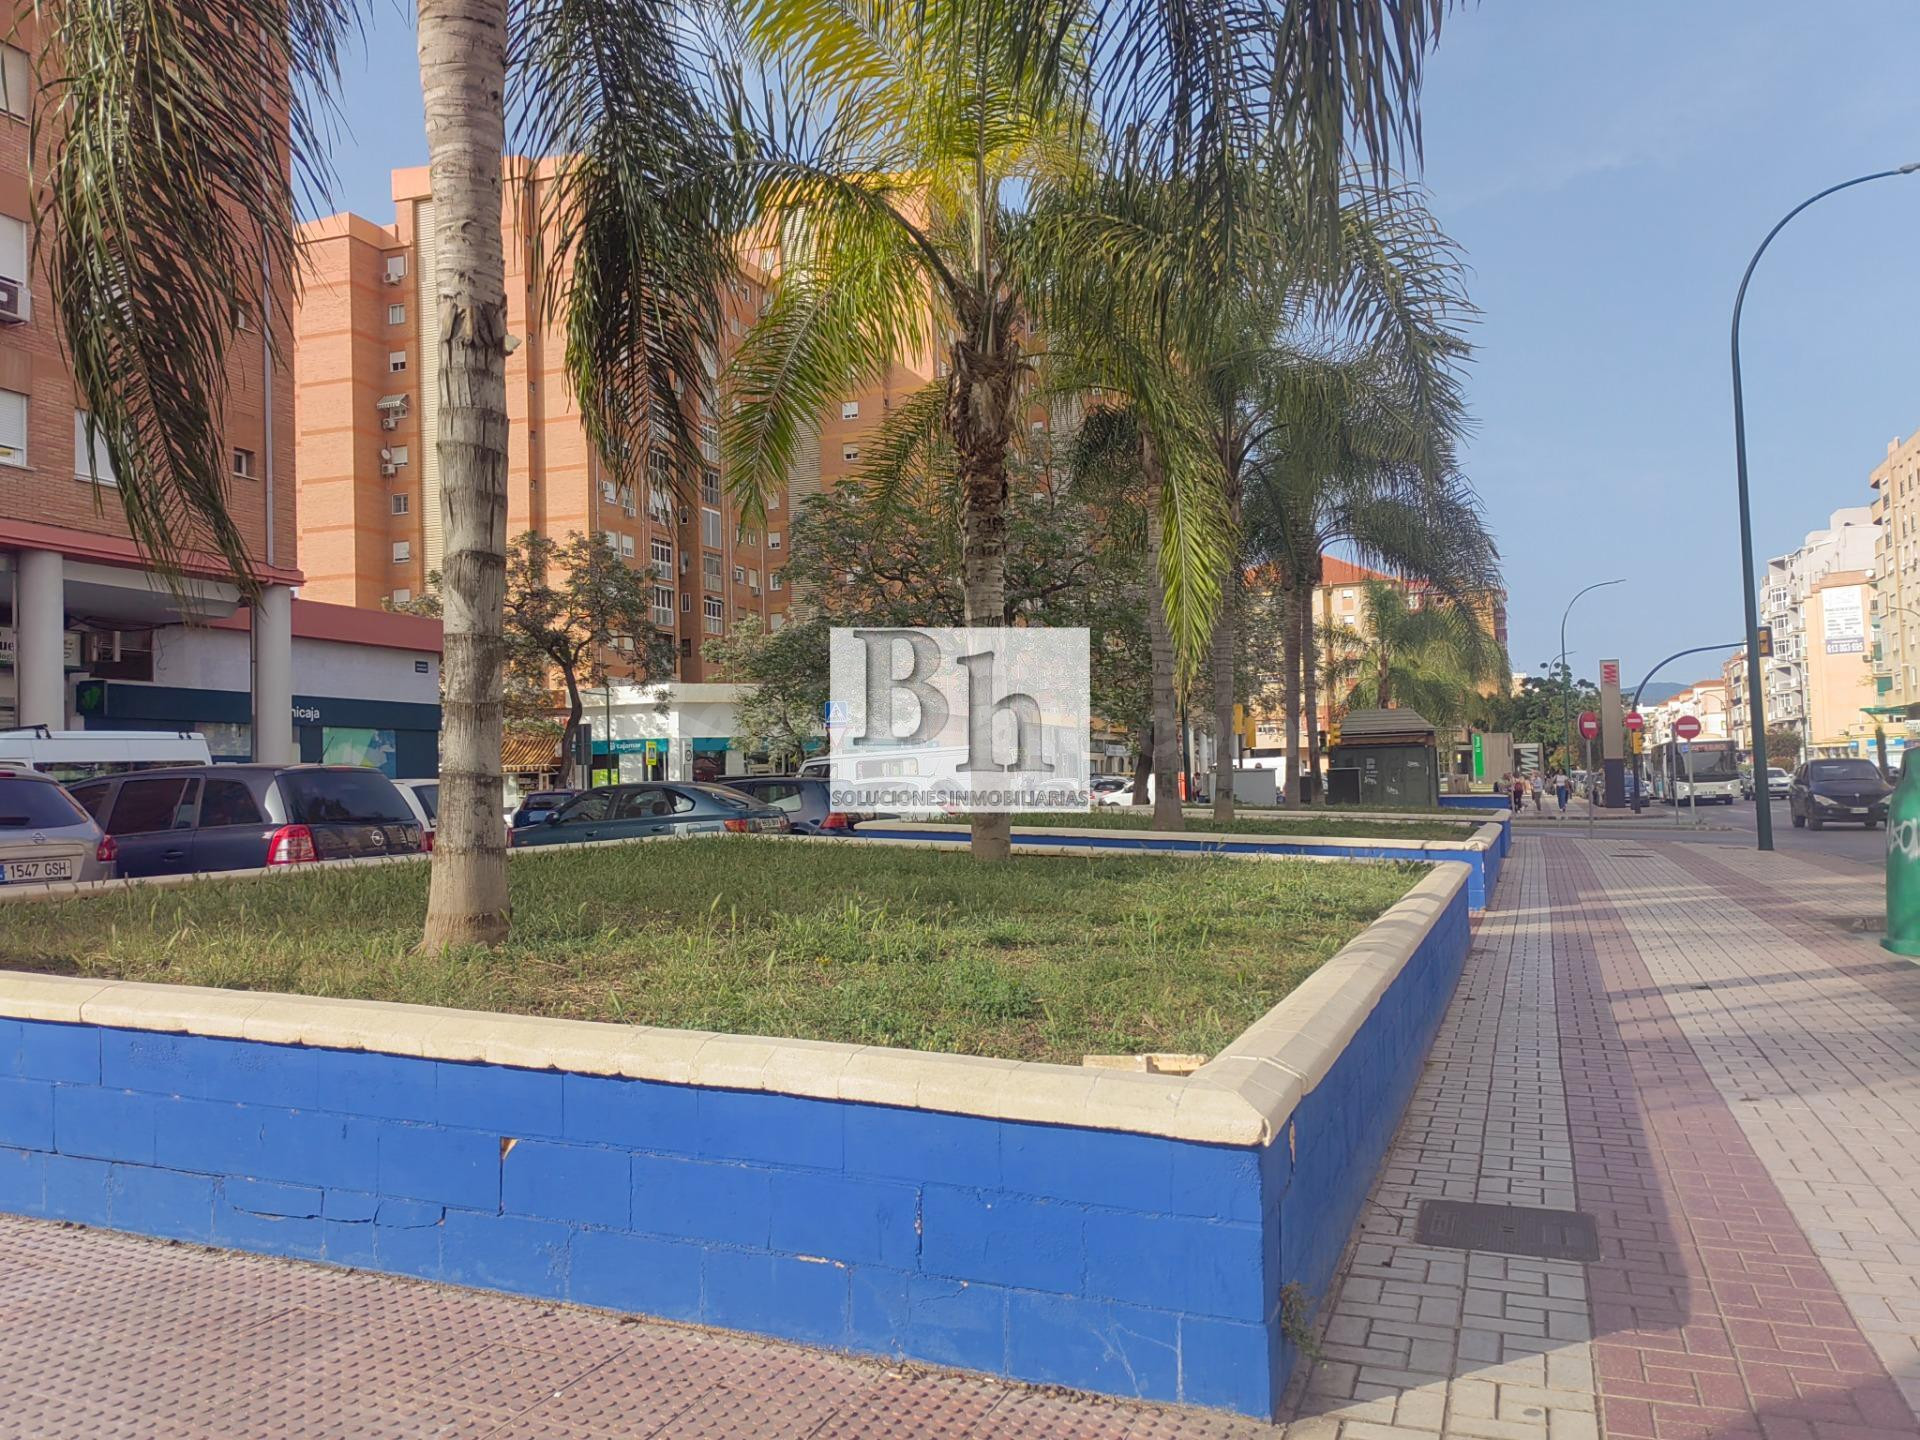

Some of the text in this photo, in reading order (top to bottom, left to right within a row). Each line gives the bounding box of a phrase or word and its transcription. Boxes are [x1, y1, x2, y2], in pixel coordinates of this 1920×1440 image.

[291, 706, 320, 721] nicaja
[10, 862, 66, 878] 1547 GSH
